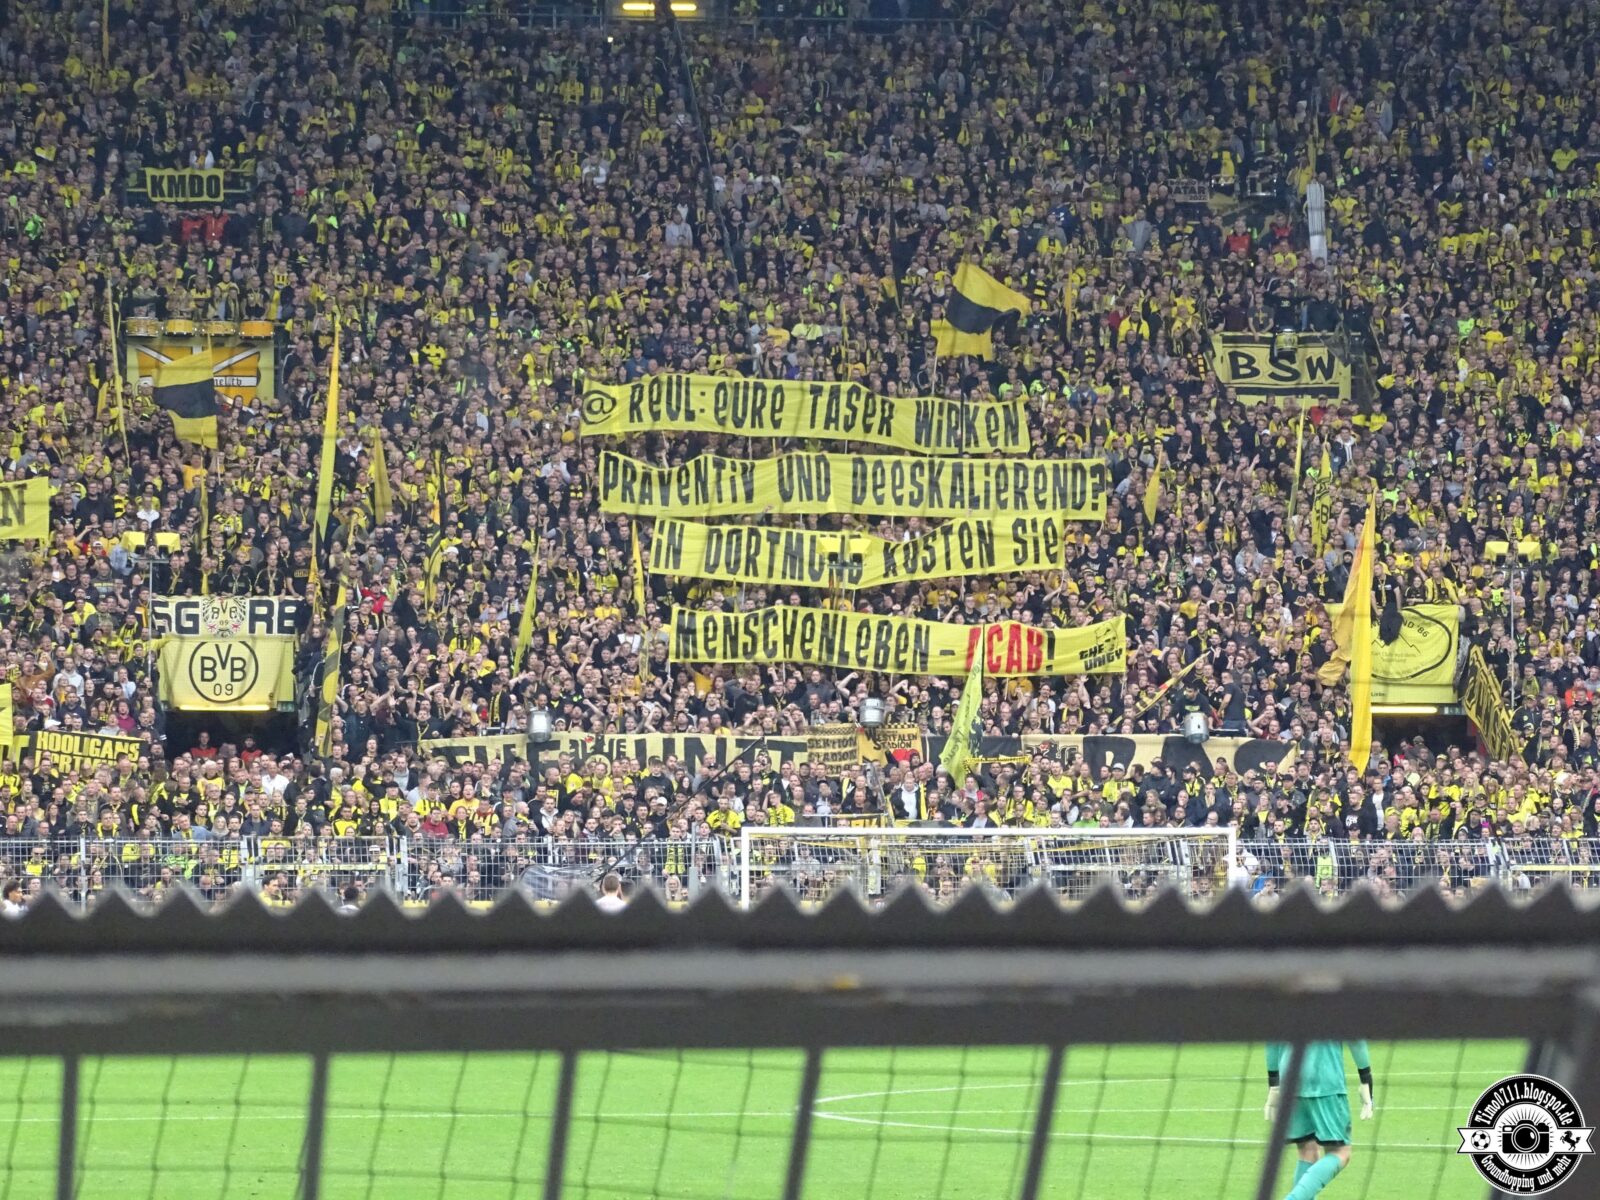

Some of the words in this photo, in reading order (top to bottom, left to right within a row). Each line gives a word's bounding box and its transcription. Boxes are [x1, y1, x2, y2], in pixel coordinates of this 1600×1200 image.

[150, 174, 221, 198] KMDO
[1228, 350, 1336, 382] BSW
[582, 390, 617, 425] @
[777, 454, 831, 502] UND
[200, 643, 247, 683] BVB
[213, 683, 234, 696] 09
[36, 731, 140, 760] HOOLIGANS
